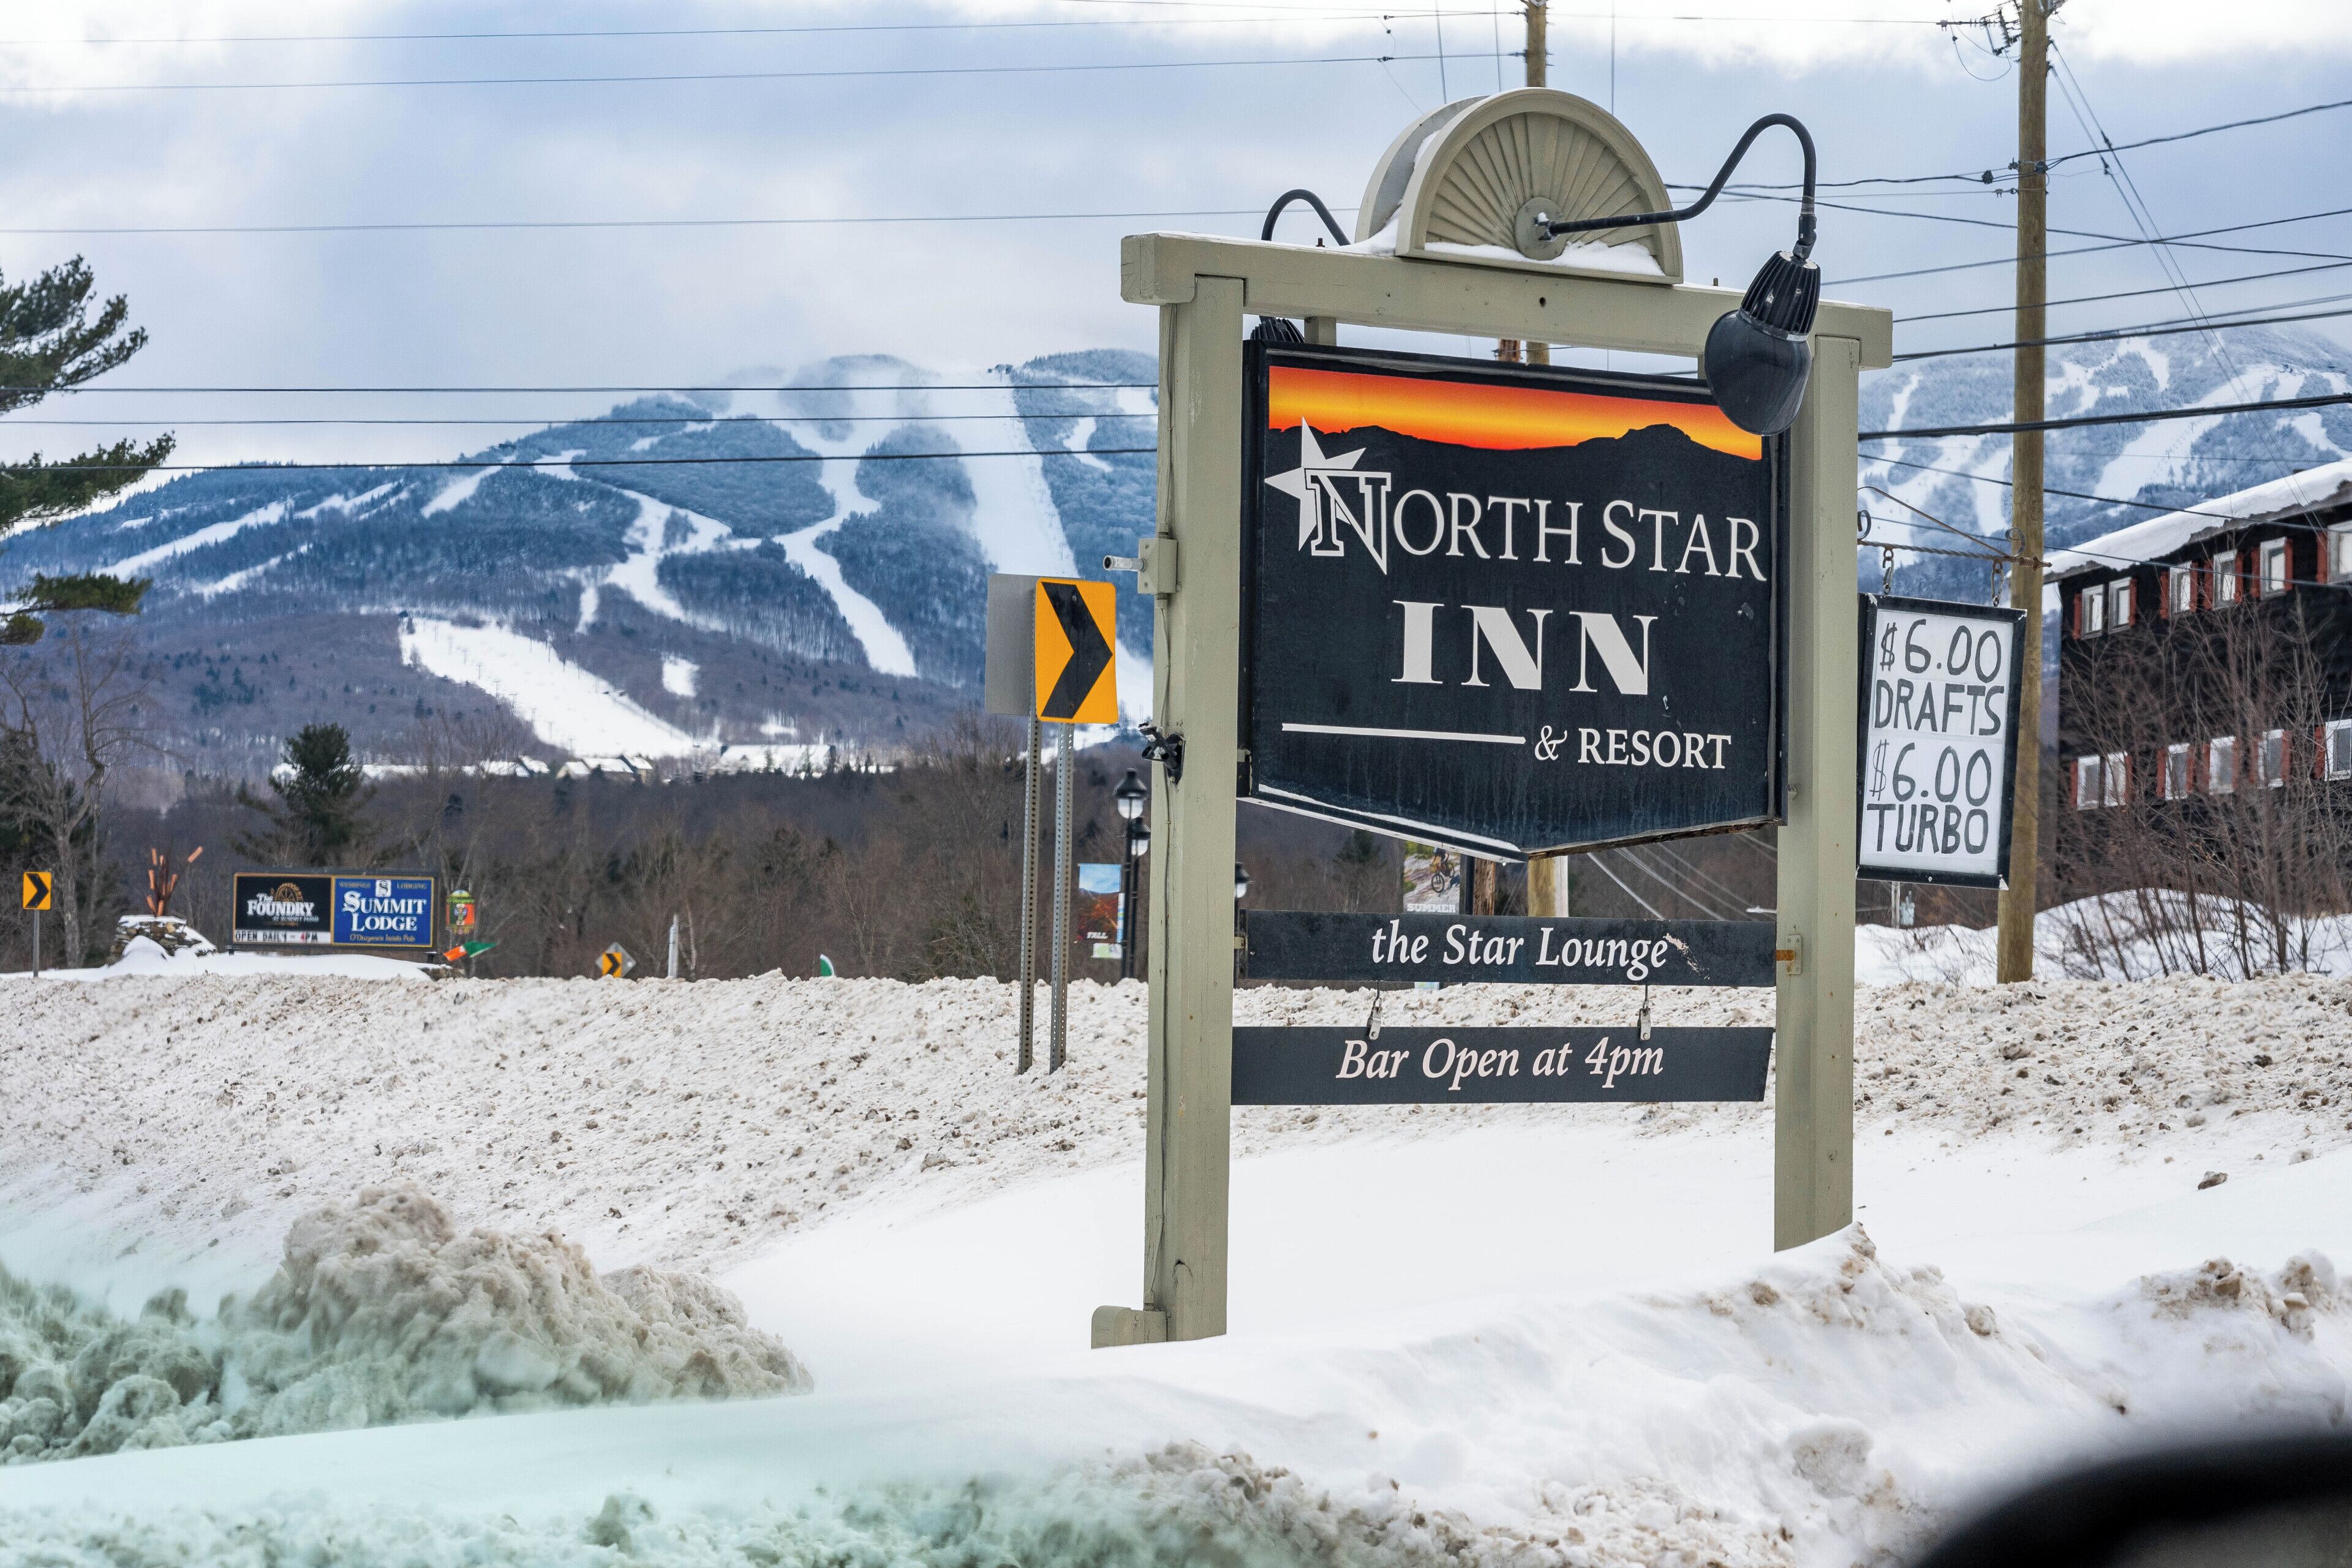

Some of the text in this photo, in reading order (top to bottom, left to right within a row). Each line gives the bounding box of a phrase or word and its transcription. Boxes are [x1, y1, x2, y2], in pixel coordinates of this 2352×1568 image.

[1305, 469, 1766, 581] NORTH STAR
[1391, 600, 1658, 695] INN
[1880, 619, 2001, 683] $6.00
[1874, 679, 2004, 736] DRAFTS
[1535, 725, 1732, 769] & RESORT
[1869, 739, 1992, 807] $6.00
[1867, 804, 1988, 854] TURBO
[247, 899, 314, 916] FOUNDRY
[342, 891, 427, 914] SUMMIT
[352, 913, 417, 932] LODGE
[1407, 903, 1456, 913] SUMMER
[235, 931, 257, 941] OPEN
[263, 931, 287, 942] DAILY
[1372, 919, 1668, 980] the Star Lounge
[1336, 1037, 1664, 1090] Bar Open at 4pm
